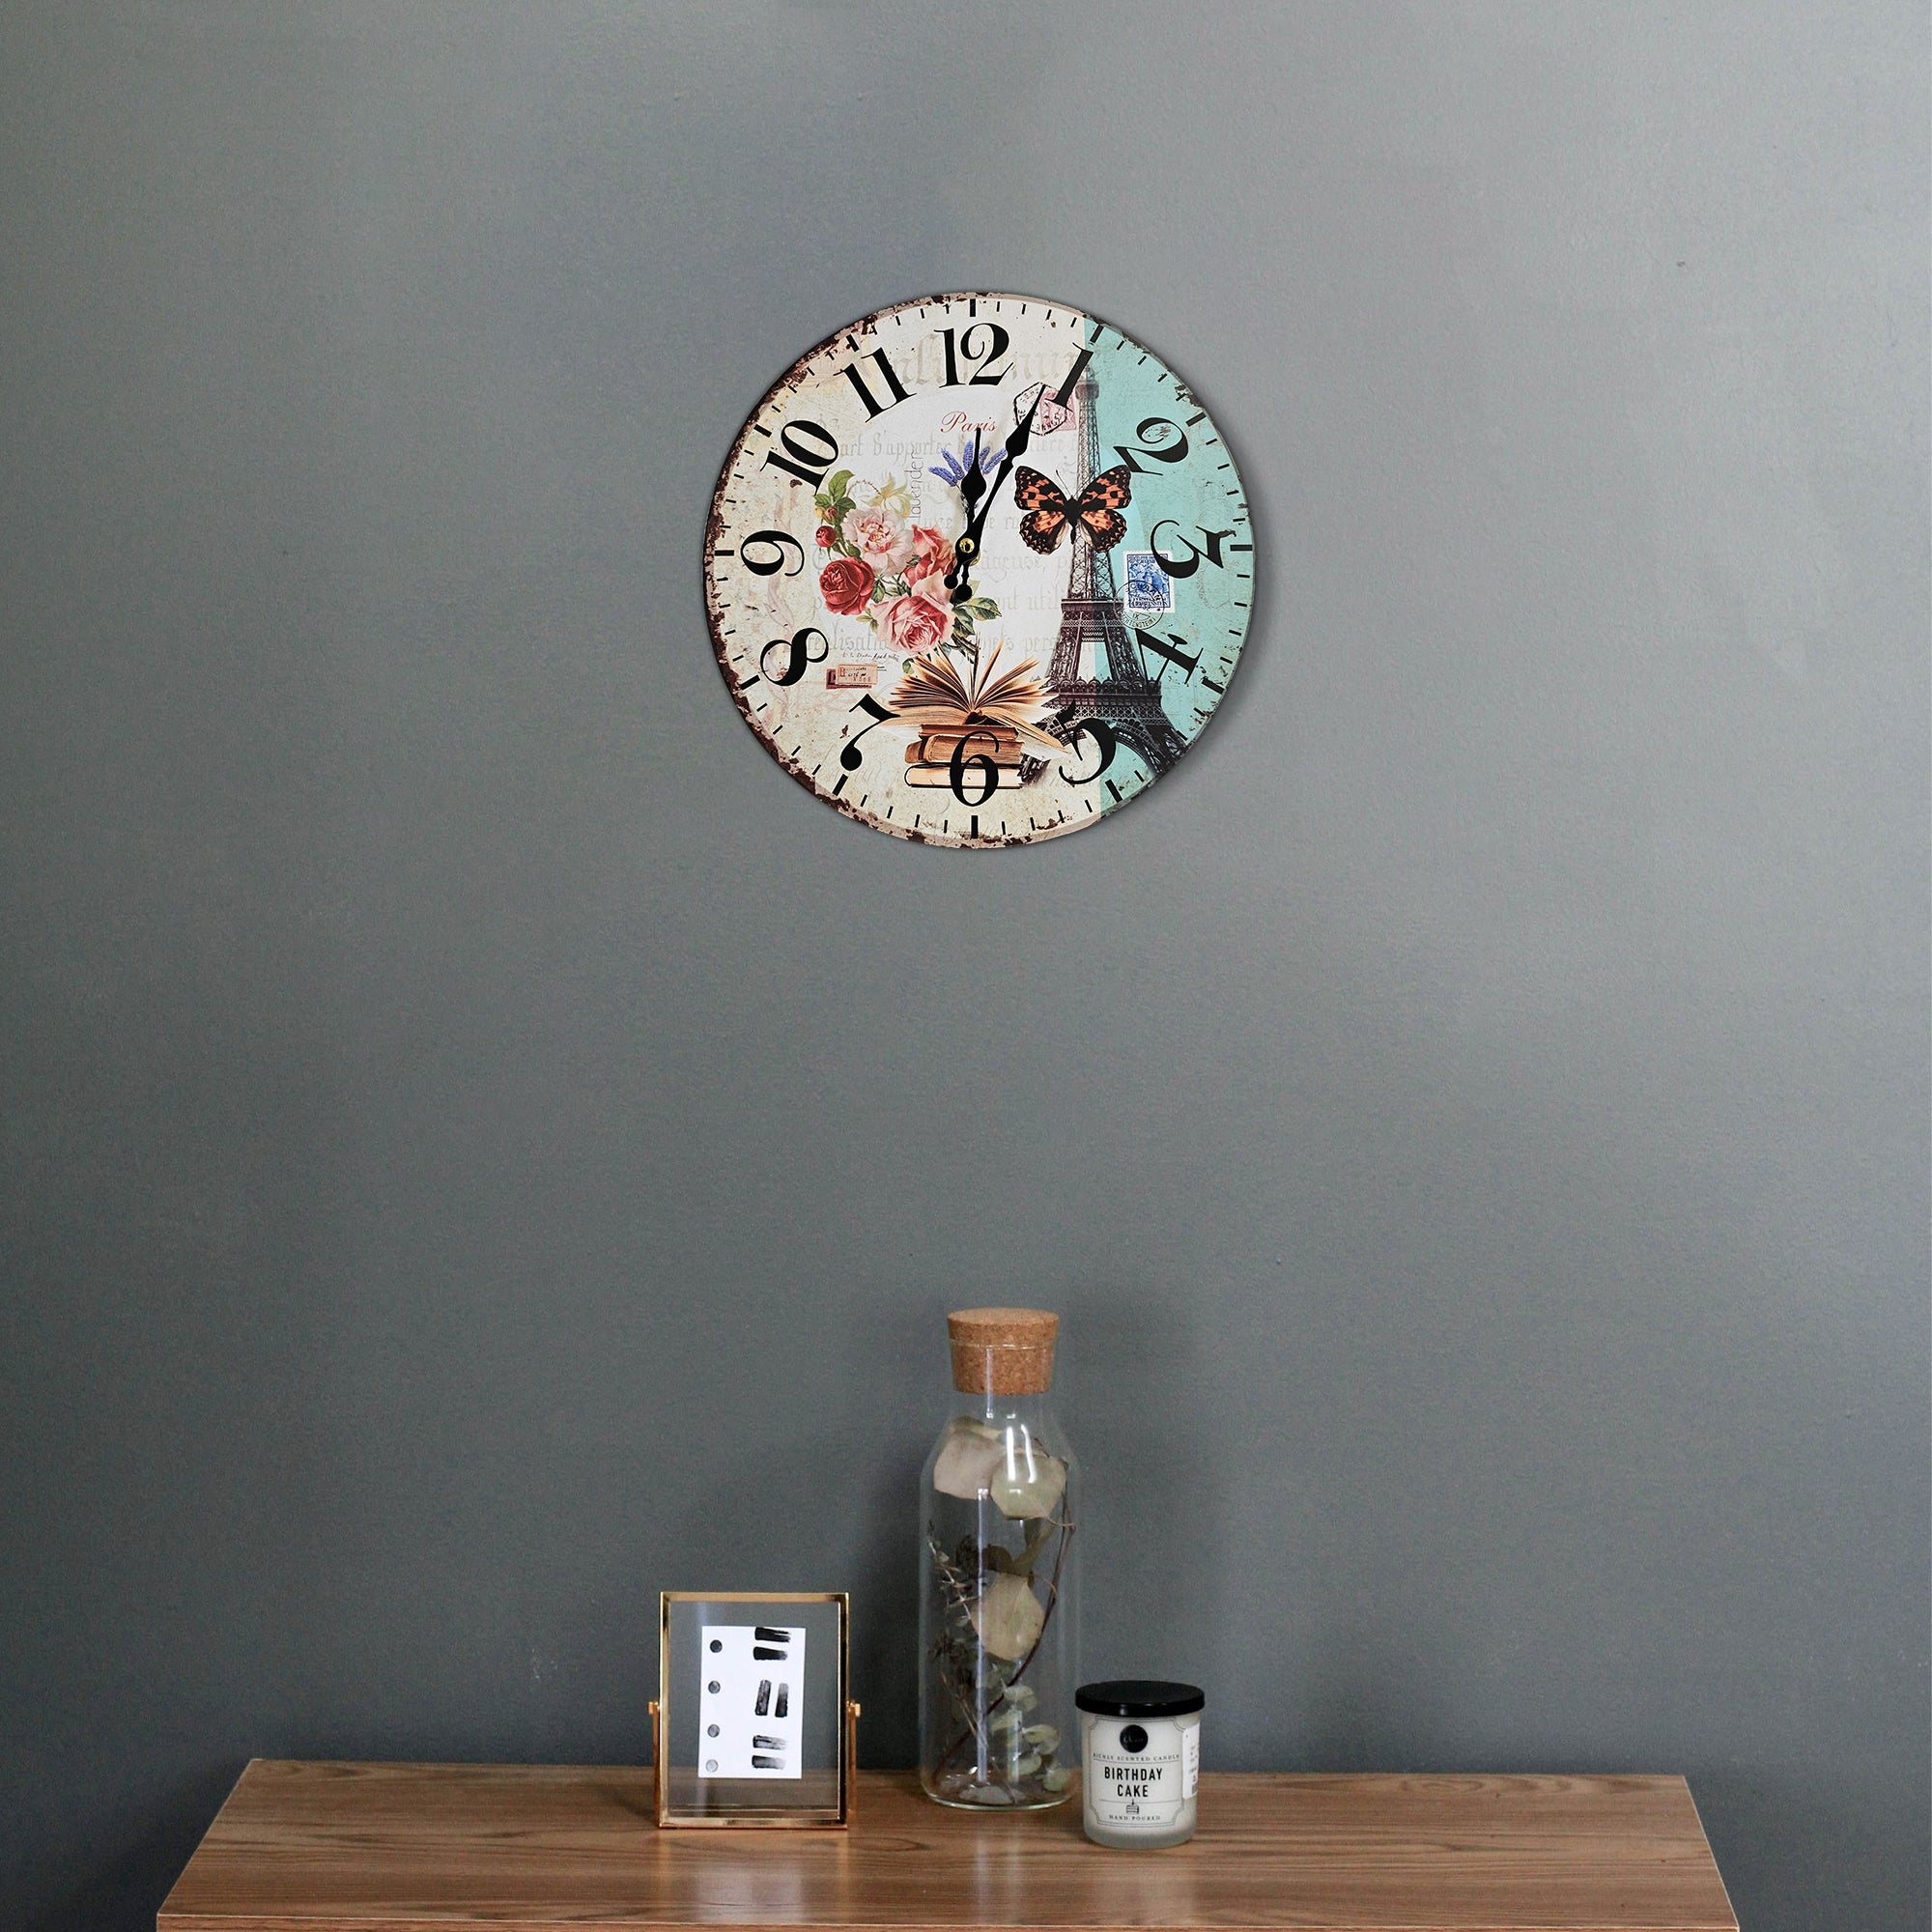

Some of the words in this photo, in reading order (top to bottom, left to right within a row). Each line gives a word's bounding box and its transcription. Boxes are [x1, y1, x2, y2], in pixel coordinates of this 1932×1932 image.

[834, 347, 917, 423] 11
[933, 323, 1014, 388] 12
[1044, 342, 1094, 412] 1
[940, 411, 998, 433] Paris
[1112, 416, 1189, 476] 2
[760, 417, 839, 496] 10
[904, 446, 924, 519] lavender
[741, 530, 805, 577] 9
[1151, 520, 1237, 579] 3
[759, 628, 829, 687] 8
[1134, 628, 1204, 687] 4
[839, 694, 901, 772] 7
[1059, 699, 1117, 785] 5
[950, 731, 1000, 807] 6
[1104, 1766, 1163, 1781] BIRTHDAY
[1117, 1784, 1149, 1798] CAKE
